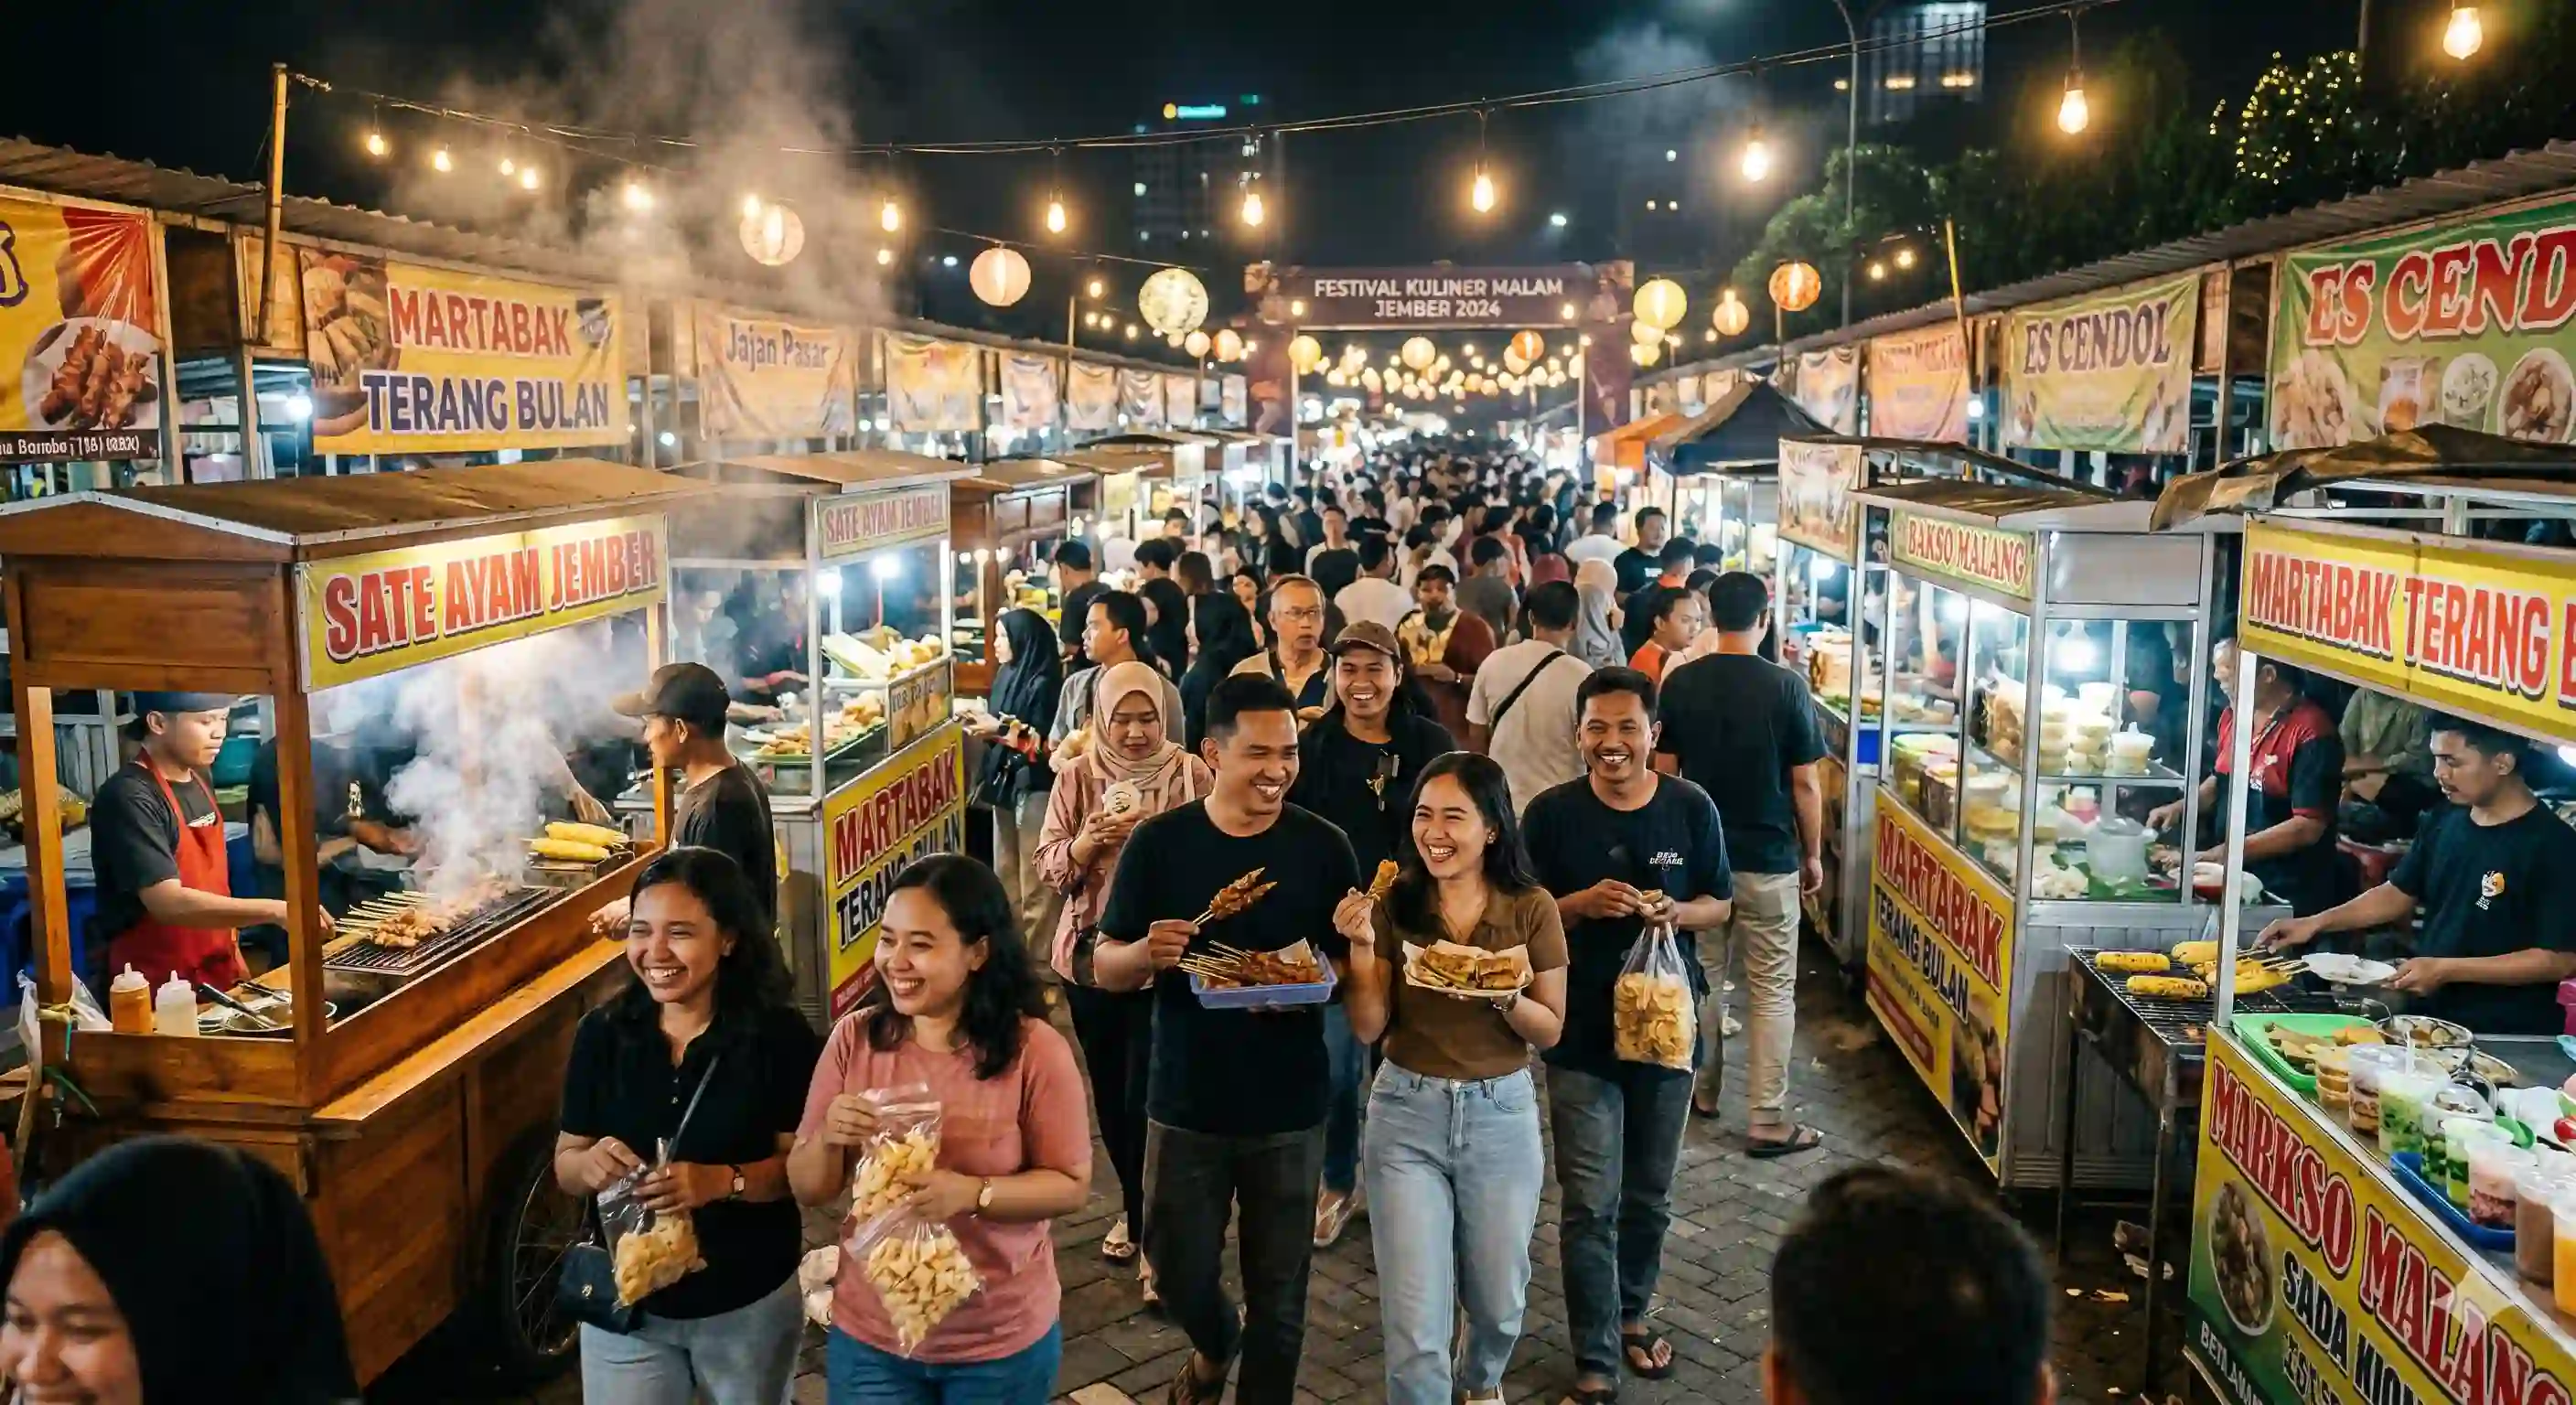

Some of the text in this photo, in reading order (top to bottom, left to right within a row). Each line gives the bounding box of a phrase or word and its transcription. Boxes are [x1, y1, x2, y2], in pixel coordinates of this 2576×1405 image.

[388, 285, 572, 357] MARTABAK
[1315, 278, 1563, 297] FESTIVAL KULINER MALAM
[1375, 299, 1502, 317] JEMBER 2024
[2305, 261, 2376, 347] ES
[726, 322, 831, 372] Jajan Pasar
[2023, 319, 2053, 374] ES
[2058, 301, 2171, 372] CENDOL
[361, 371, 609, 434] TERANG BULAN
[825, 505, 859, 544] SATE
[863, 499, 897, 537] AYAM
[1907, 516, 1955, 567] BAKSO
[1956, 526, 2027, 589] MALANG
[323, 529, 659, 664] SATE AYAM JEMBER
[2248, 552, 2399, 661] MARTABAK
[2403, 575, 2551, 702] TERANG
[834, 742, 959, 888] MARTABAK
[1877, 810, 2005, 995] MARTABAK
[1874, 883, 1920, 971] TERANG
[1922, 933, 1970, 1025] BULAN
[2210, 1056, 2572, 1405] MARKSO MALAN
[2281, 1249, 2350, 1378] SADA
